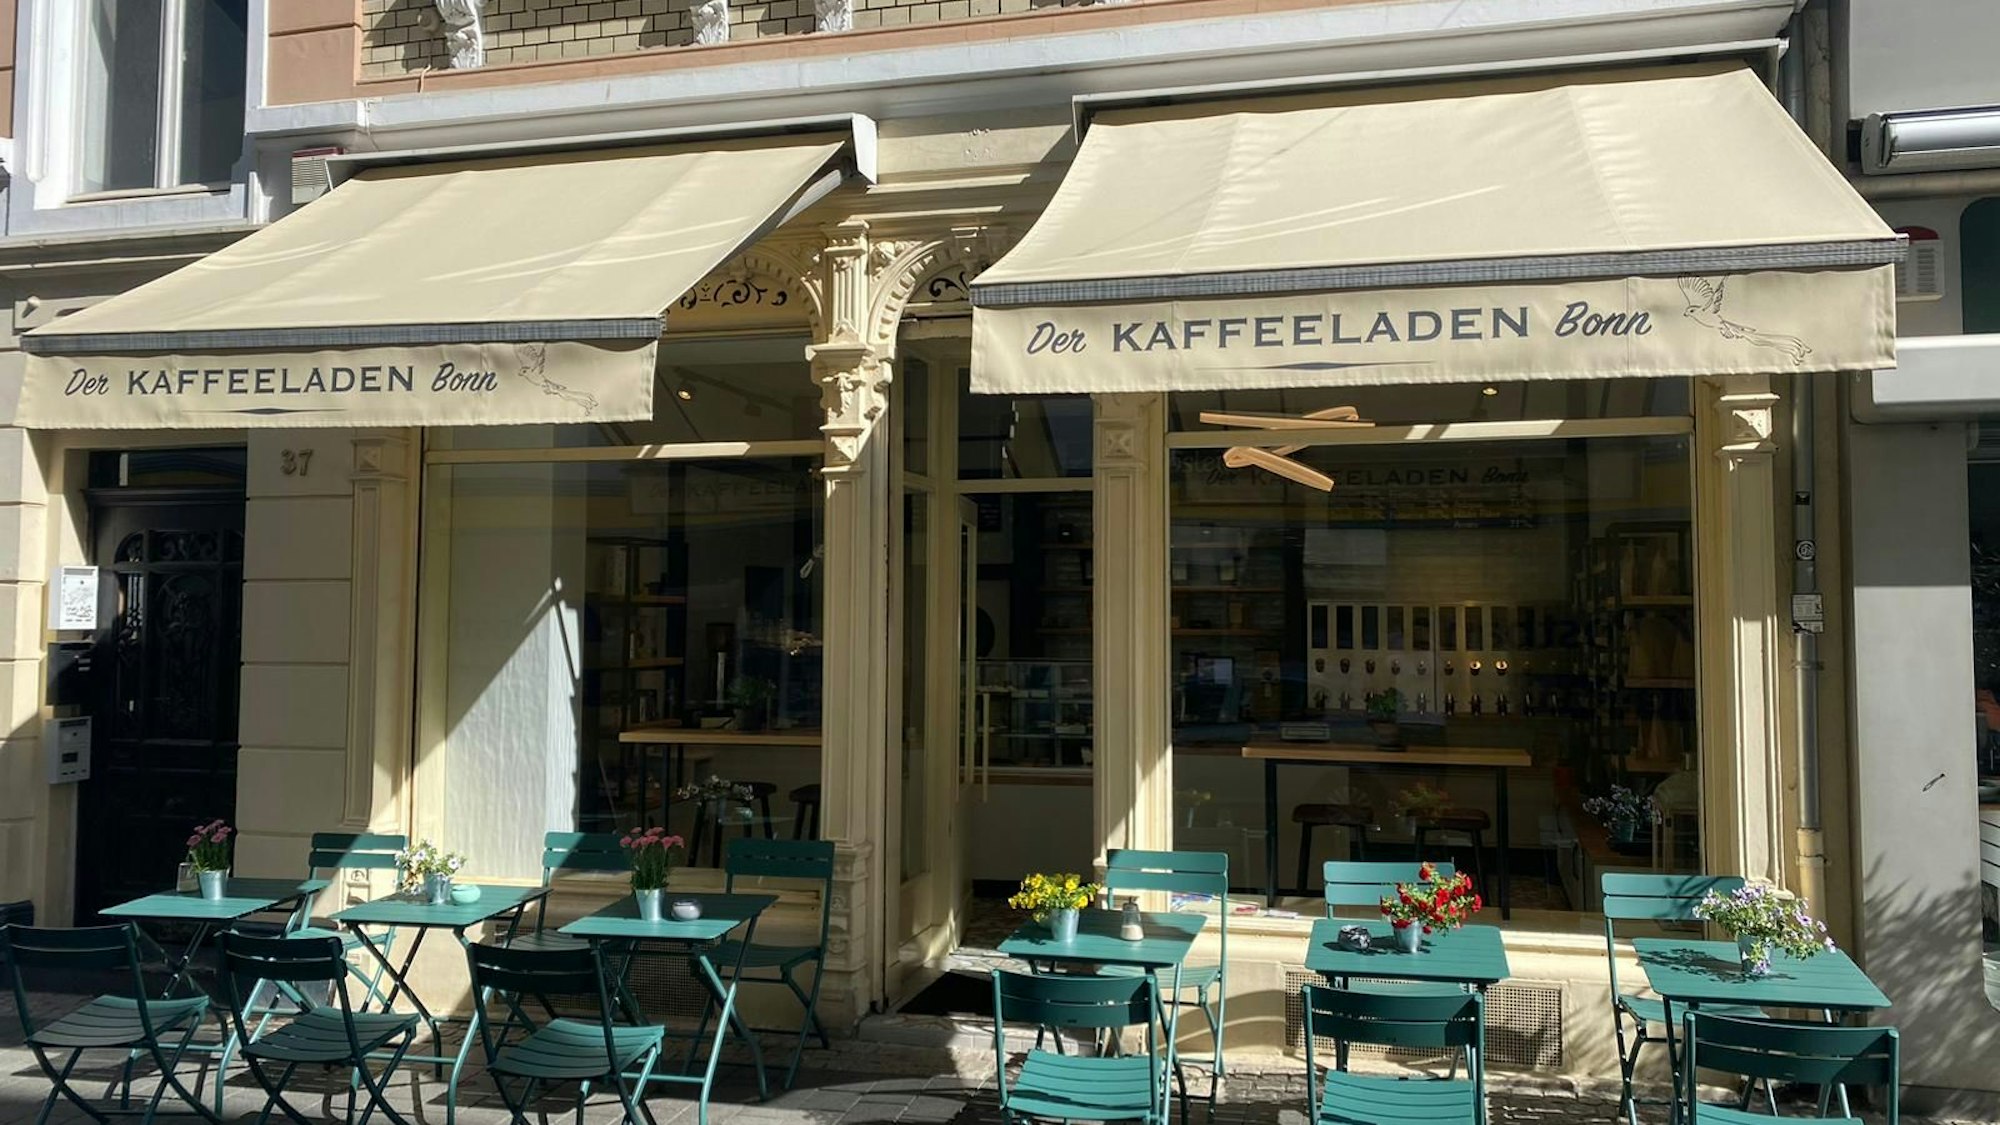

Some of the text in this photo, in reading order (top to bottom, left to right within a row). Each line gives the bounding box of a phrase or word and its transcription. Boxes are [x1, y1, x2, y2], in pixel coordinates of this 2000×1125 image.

[1026, 300, 1653, 355] Der KAFFEELADEN Bonn
[64, 361, 499, 397] Der KAFFEELADEN Bonn
[280, 448, 314, 477] 37
